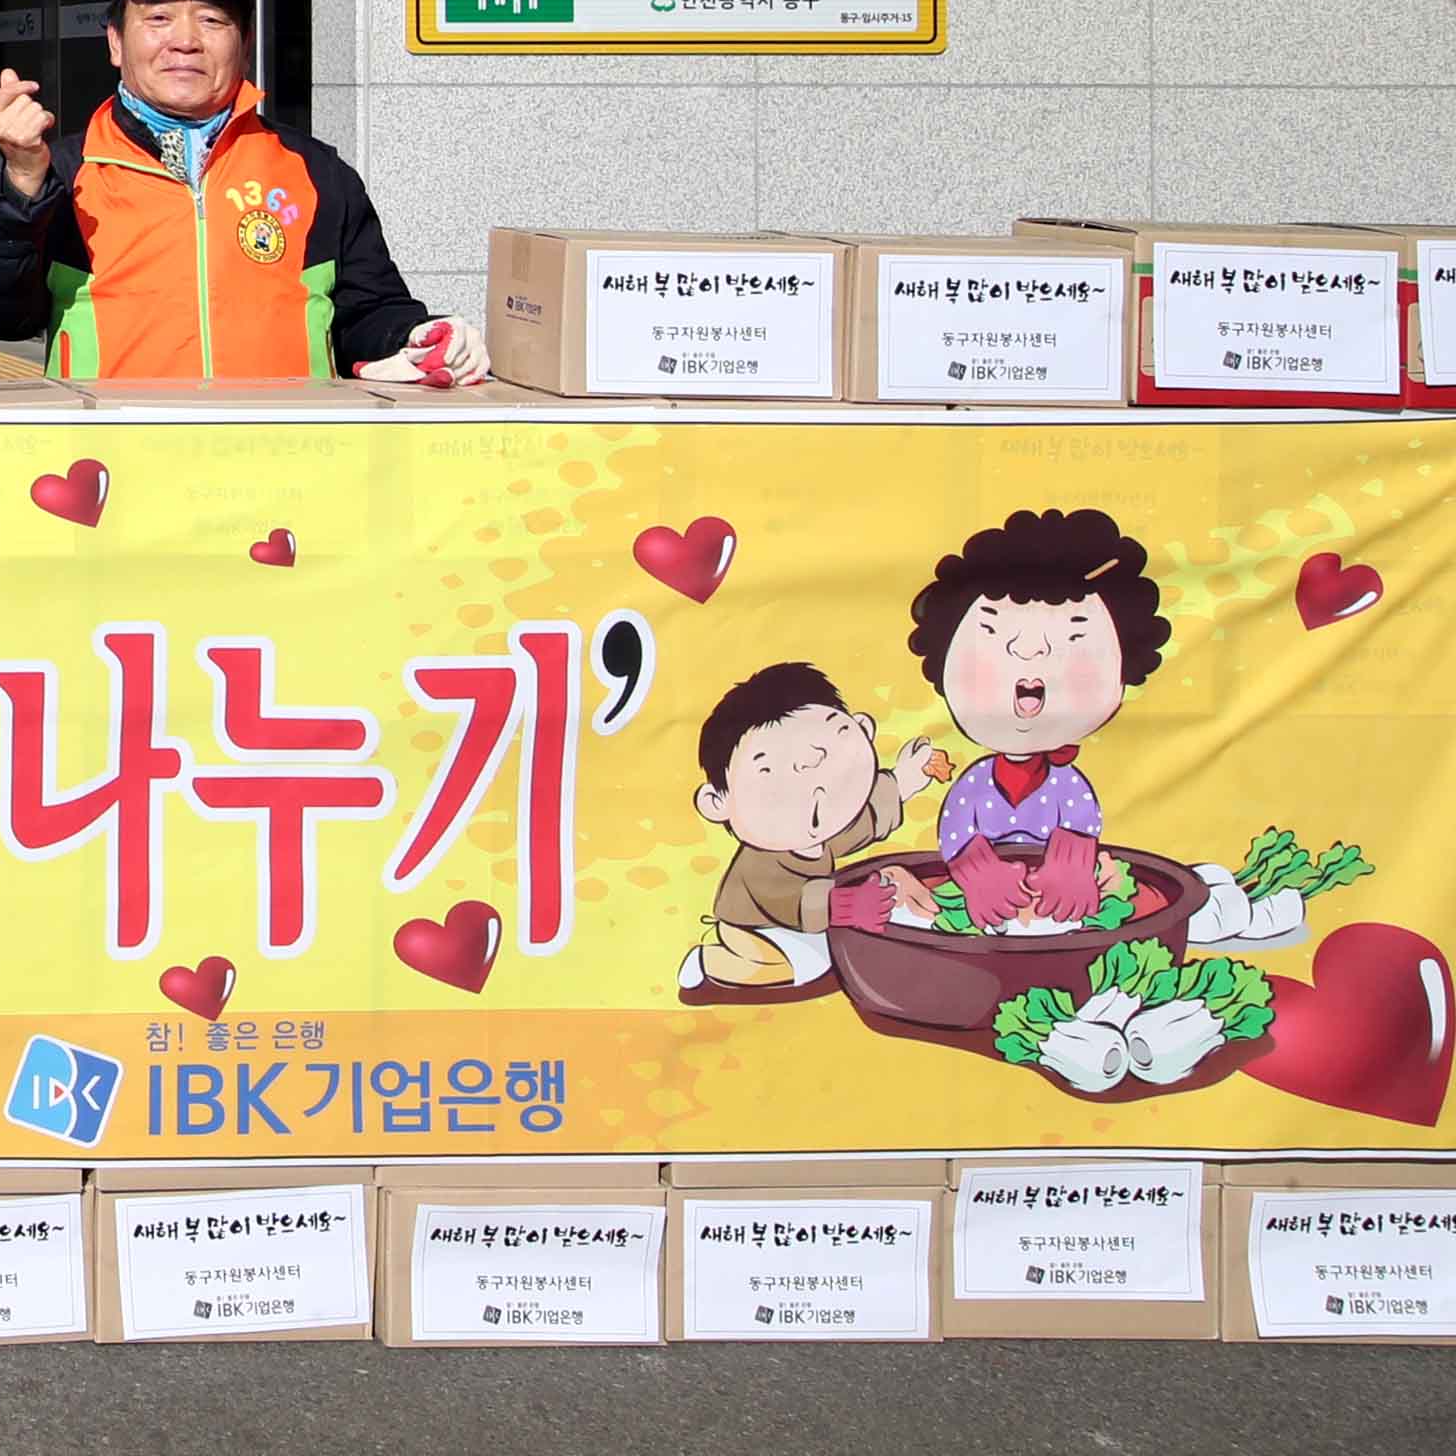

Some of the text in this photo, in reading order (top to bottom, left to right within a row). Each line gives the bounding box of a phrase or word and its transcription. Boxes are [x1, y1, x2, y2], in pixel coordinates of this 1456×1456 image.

[225, 180, 300, 226] 1365
[602, 274, 648, 294] 새해
[654, 271, 670, 299] 복
[676, 272, 720, 297] 많이
[894, 279, 939, 300] 새해
[945, 277, 961, 304] 복
[967, 278, 1010, 303] 많이
[1169, 269, 1215, 289] 새해
[1220, 267, 1237, 294] 복
[1243, 268, 1286, 294] 많이
[651, 325, 767, 342] 동구자원봉사센터
[941, 331, 1057, 348] 동구자원봉사센터
[1216, 321, 1332, 340] 동구자원봉사센터
[146, 1020, 326, 1052] 참! 좋은 은행
[972, 1188, 1019, 1206] 새해
[1023, 1185, 1041, 1210] 복
[1045, 1185, 1089, 1208] 많이
[133, 1221, 179, 1241] 새해
[185, 1216, 201, 1243] 복
[207, 1215, 251, 1240] 많이
[430, 1227, 477, 1245] 새해
[481, 1224, 499, 1249] 복
[503, 1225, 548, 1248] 많이
[1018, 1235, 1135, 1252] 동구자원봉사센터
[184, 1264, 301, 1287] 동구자원봉사센터
[475, 1275, 592, 1292] 동구자원봉사센터
